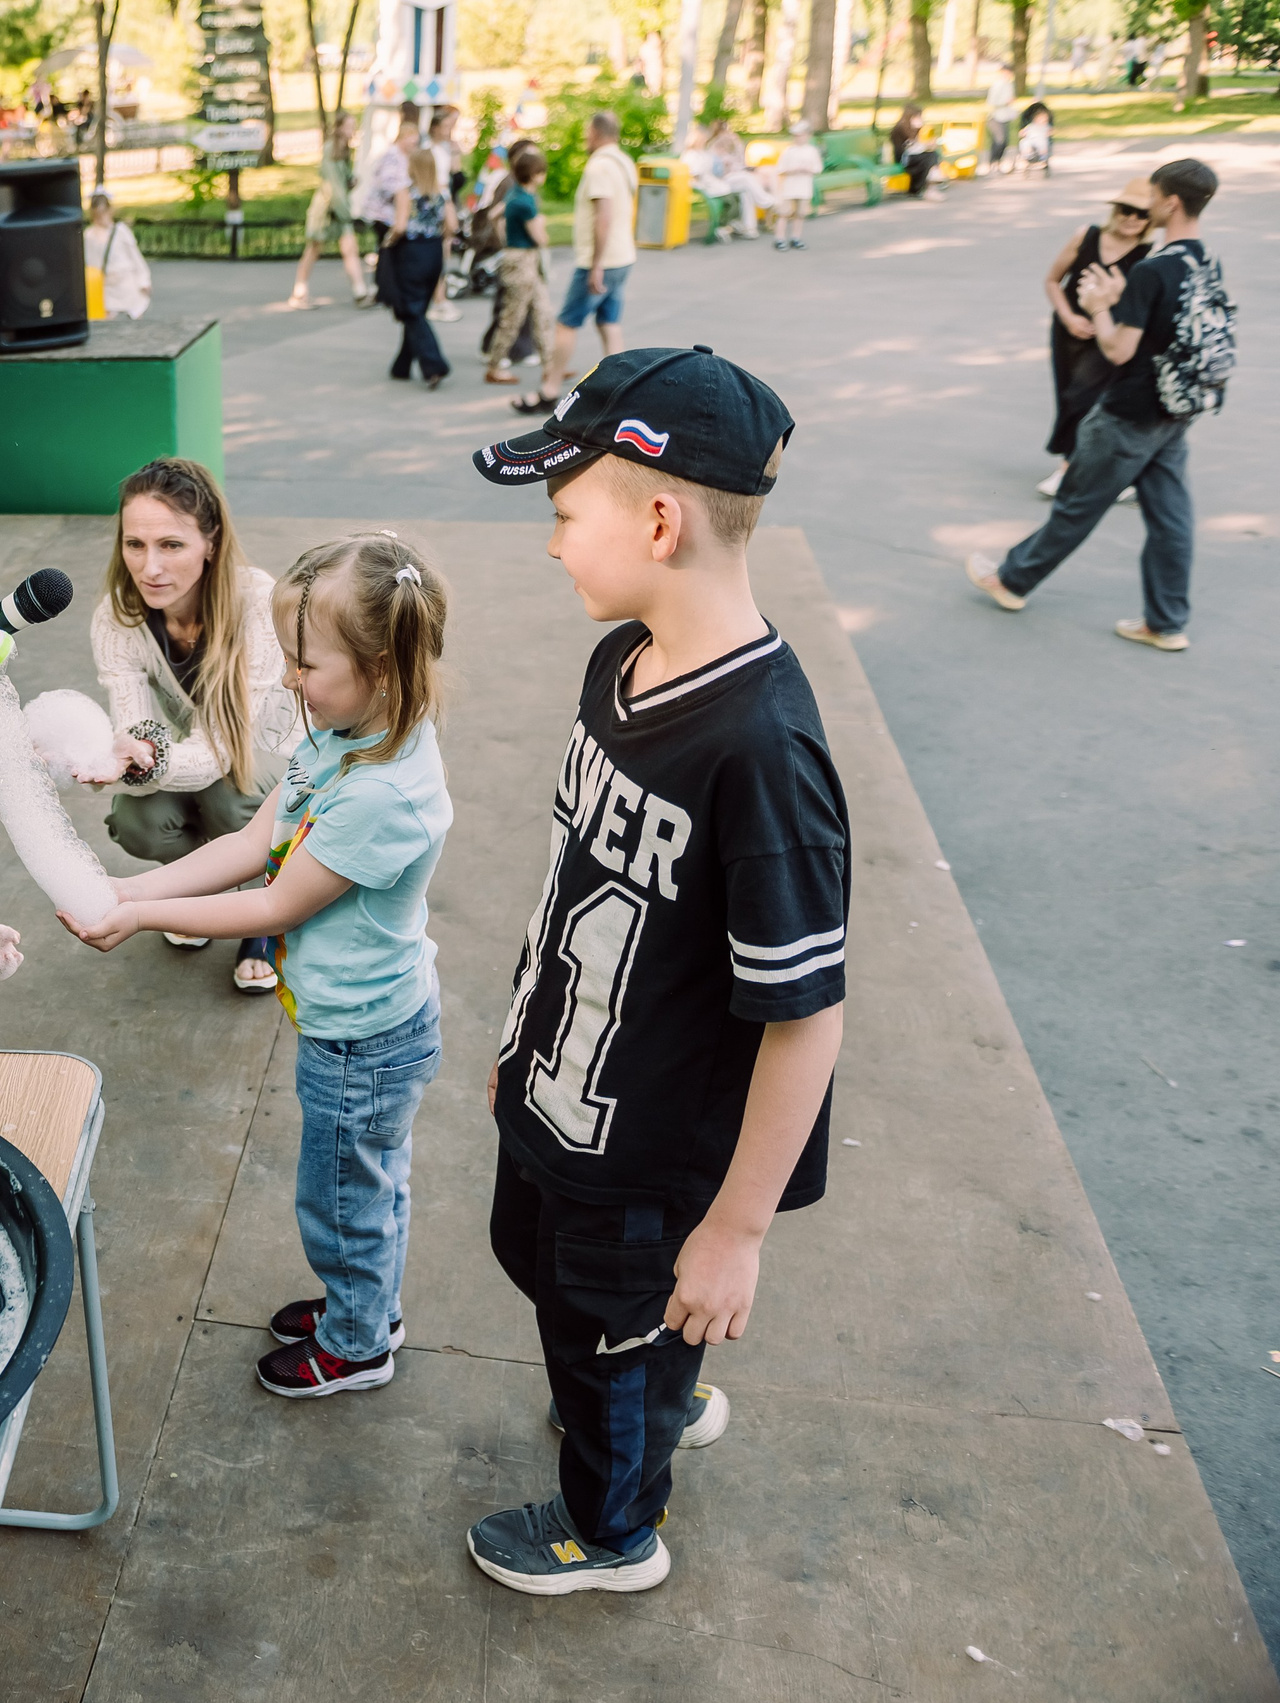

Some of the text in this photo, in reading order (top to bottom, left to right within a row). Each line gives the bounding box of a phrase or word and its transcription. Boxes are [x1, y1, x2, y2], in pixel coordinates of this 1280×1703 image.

[543, 445, 581, 469] RUSSIA
[500, 464, 536, 475] RUSSIA
[556, 706, 693, 902] OWER
